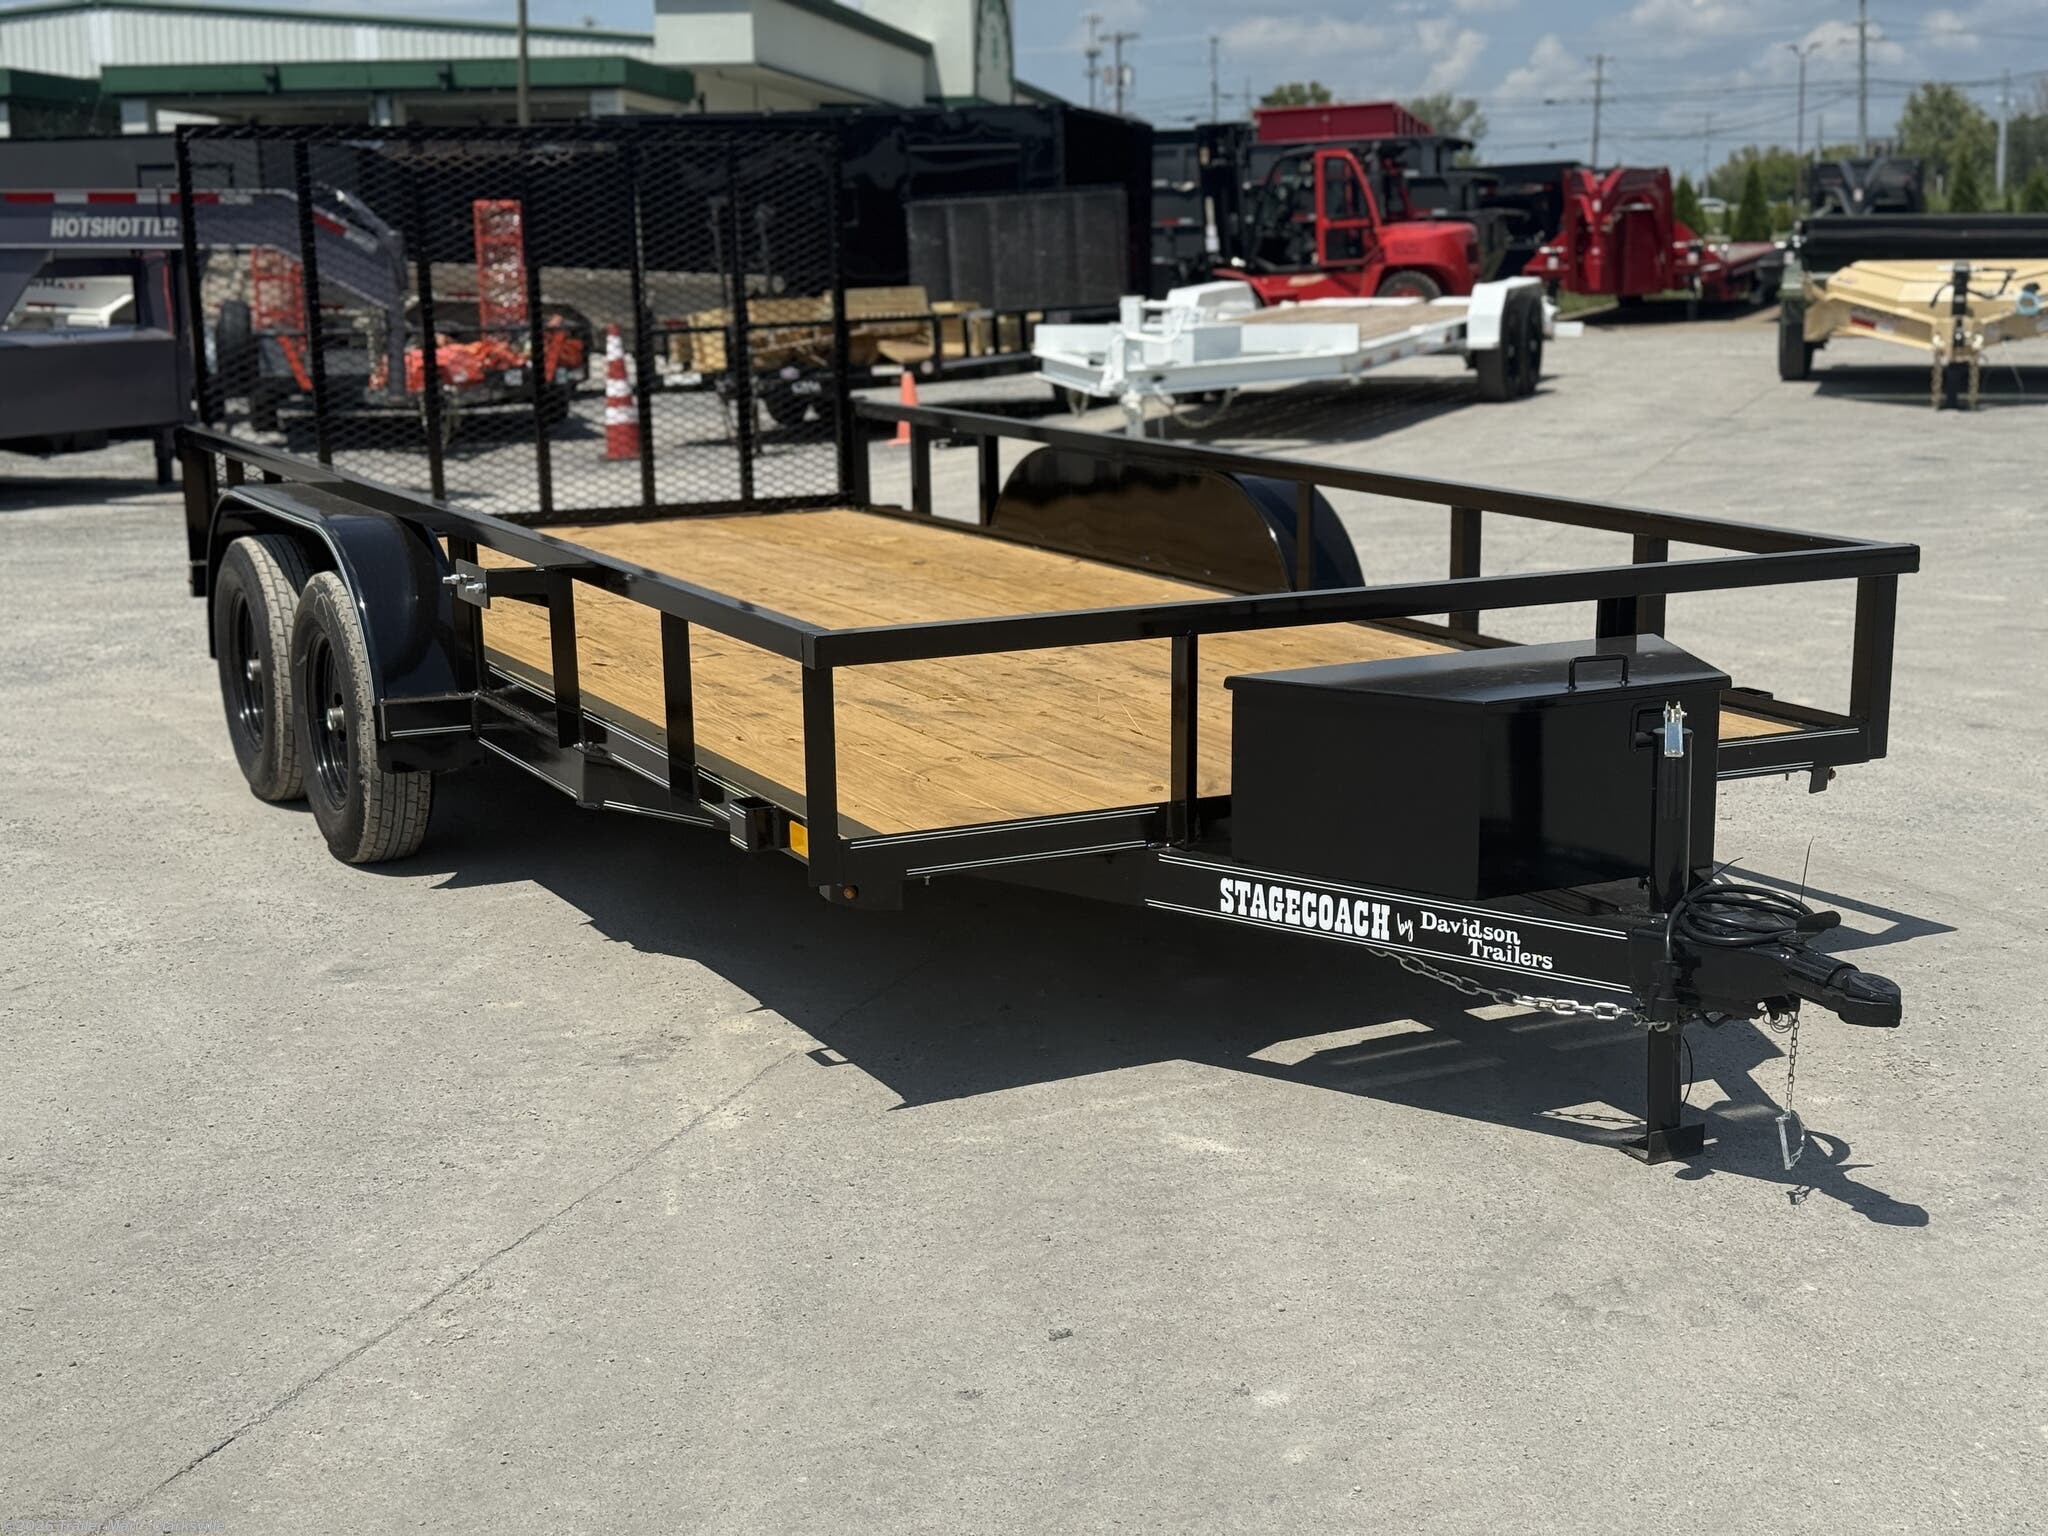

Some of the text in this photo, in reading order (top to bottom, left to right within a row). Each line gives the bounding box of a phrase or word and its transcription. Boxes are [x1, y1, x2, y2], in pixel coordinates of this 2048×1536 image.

[1219, 877, 1521, 945] STAGECOACH by Davidson
[1467, 937, 1554, 970] Trailers
